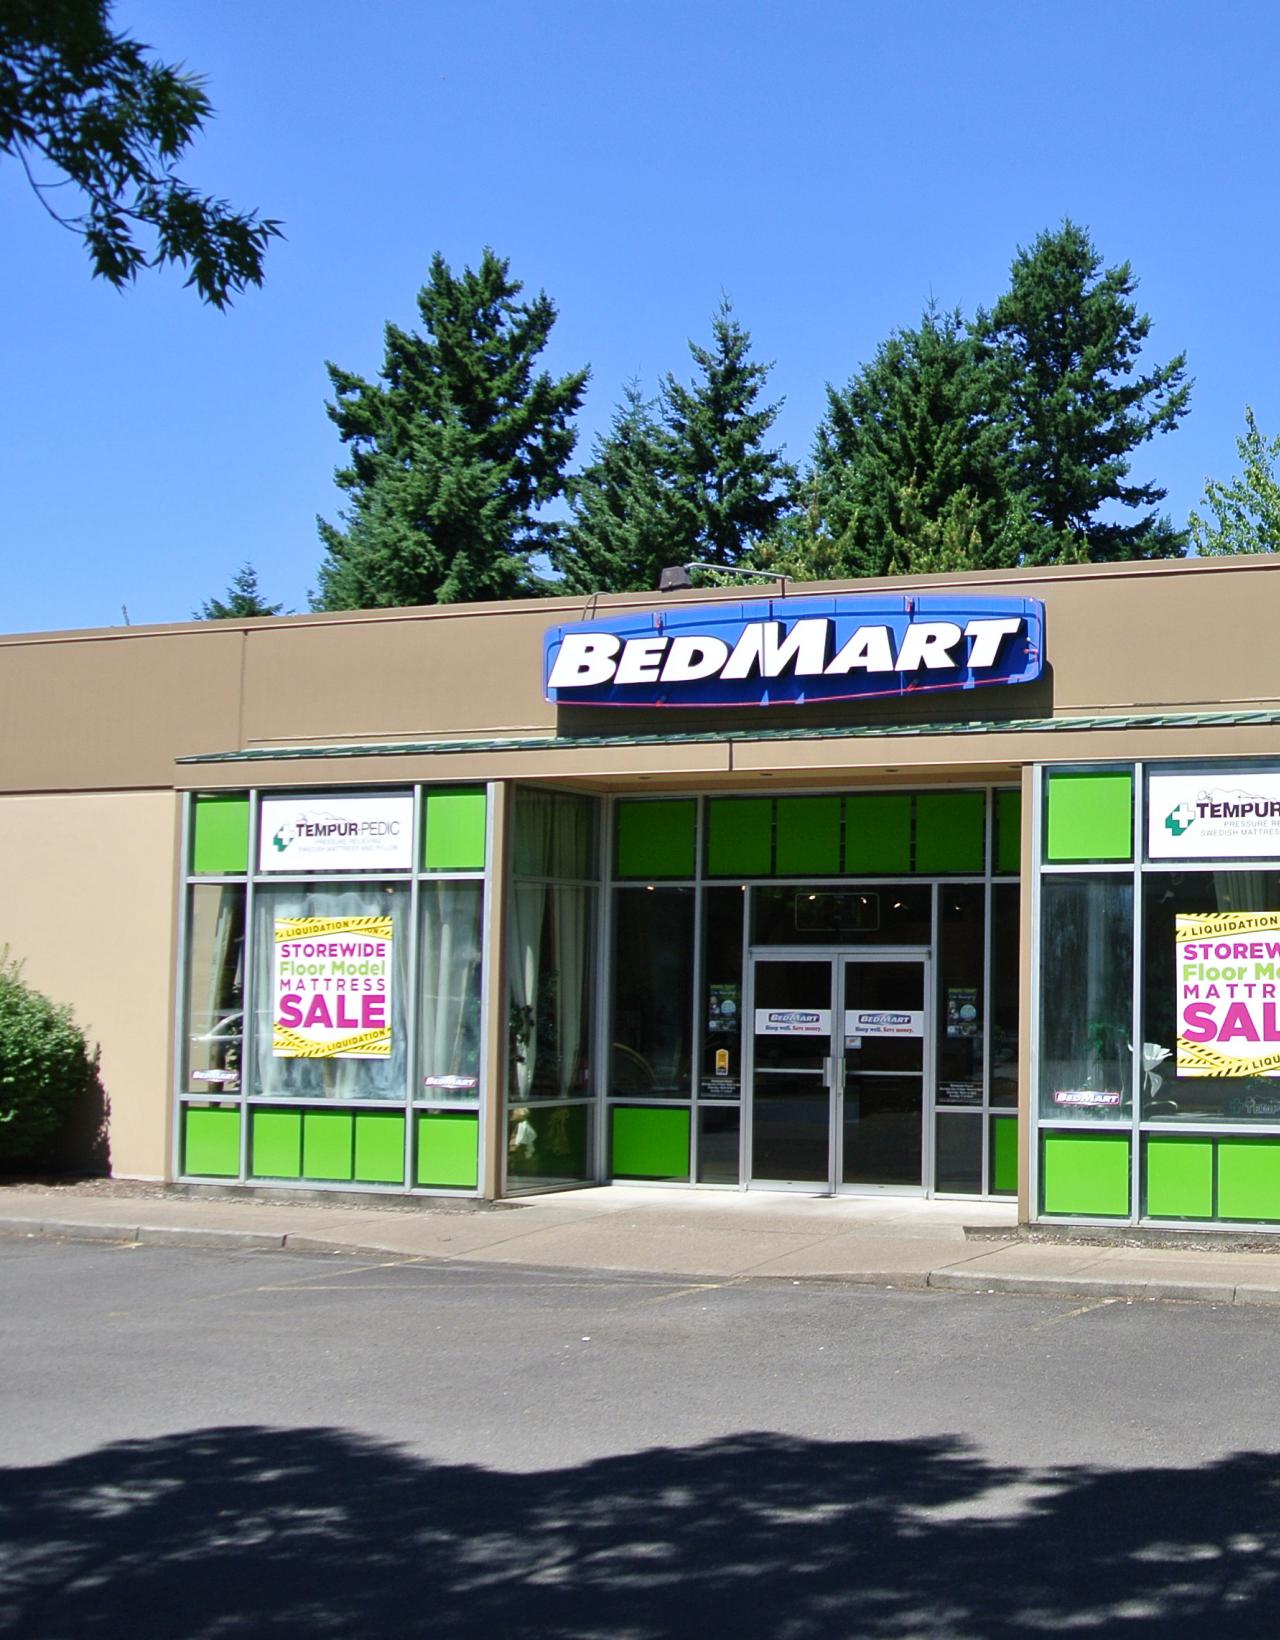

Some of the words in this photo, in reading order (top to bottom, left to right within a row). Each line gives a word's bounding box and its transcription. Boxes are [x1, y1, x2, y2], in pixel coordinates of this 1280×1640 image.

[1223, 820, 1268, 828] PRESSURE
[1200, 829, 1239, 837] SWEDISH
[286, 920, 349, 937] LIQUIDATION
[1191, 916, 1278, 936] LIQUIDATION
[281, 943, 386, 958] STOREWIDE
[279, 960, 326, 976] Floor
[331, 960, 386, 976] Model
[1183, 962, 1248, 981] Floor
[279, 978, 386, 991] MATTRESS
[277, 994, 386, 1029] SALE
[327, 1029, 386, 1051] LIQUIDATION
